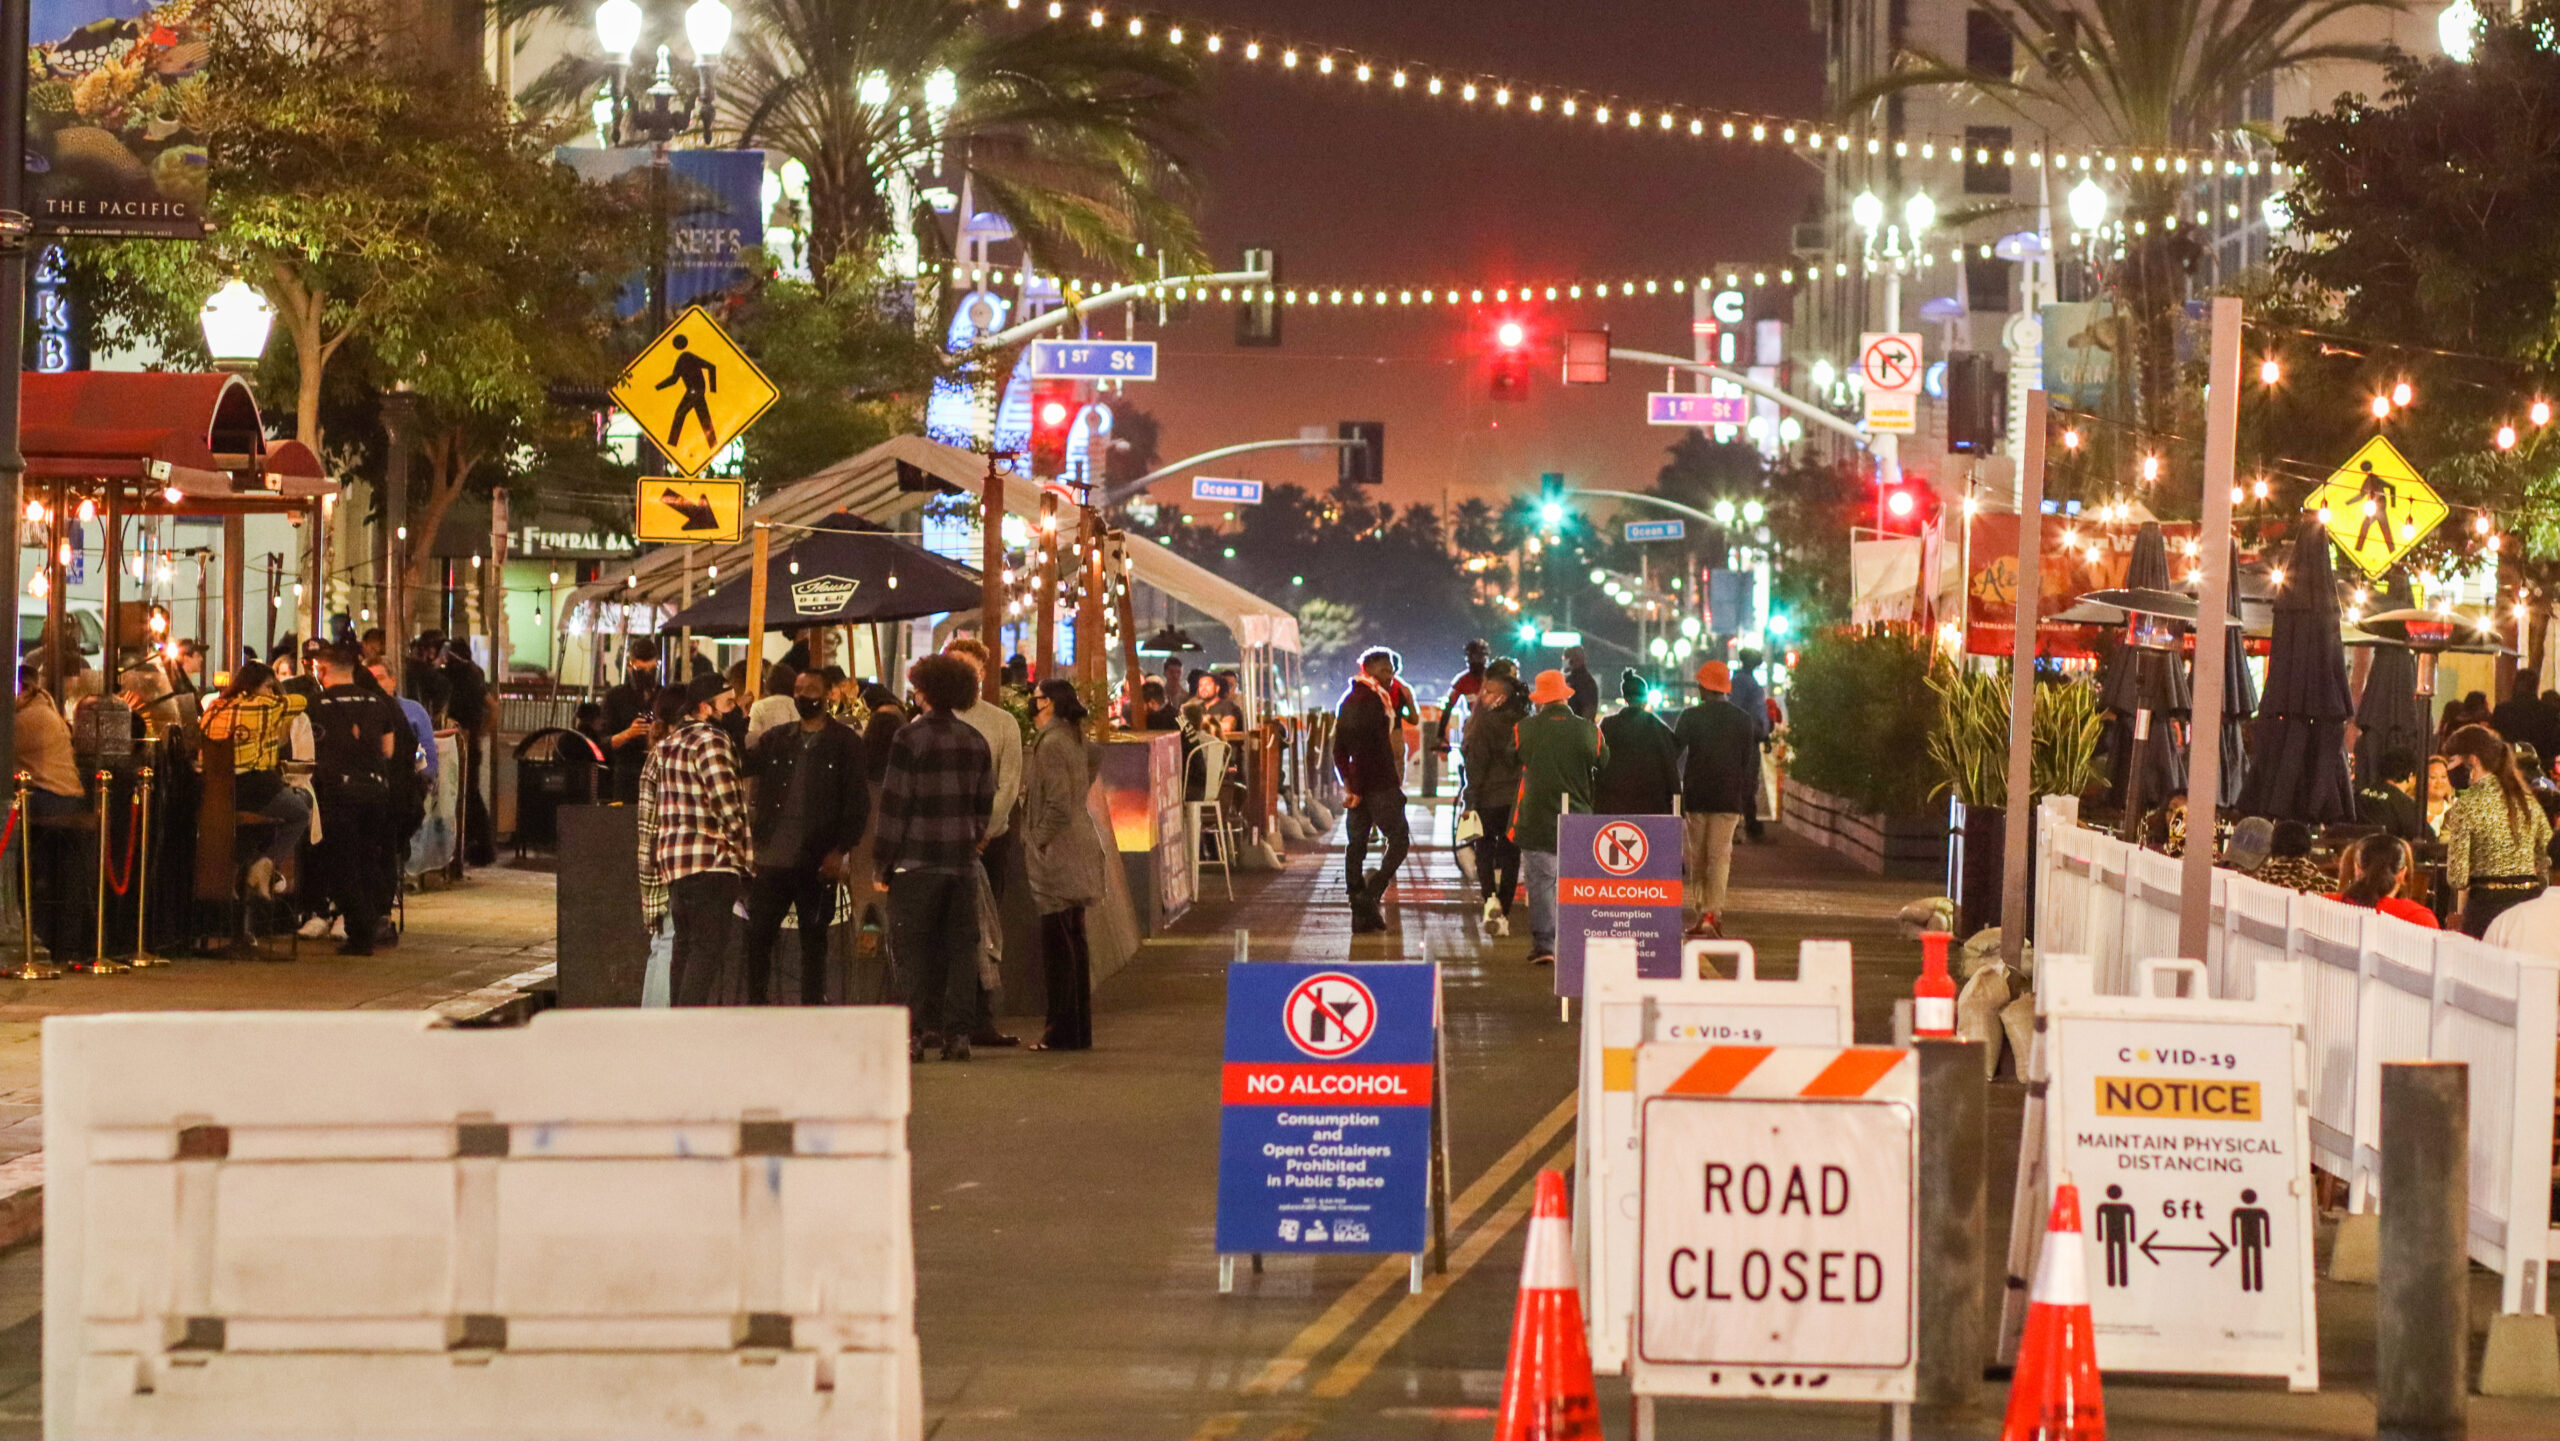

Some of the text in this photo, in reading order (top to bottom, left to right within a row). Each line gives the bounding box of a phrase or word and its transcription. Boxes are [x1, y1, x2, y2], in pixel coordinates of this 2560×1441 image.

[46, 199, 185, 217] THE PACIFIC
[1056, 348, 1135, 370] 1ST St
[1667, 400, 1732, 418] 1ST St
[1200, 482, 1237, 496] Ocean
[522, 525, 601, 554] FEDERAL
[1631, 526, 1663, 536] Ocean
[797, 580, 852, 594] House
[1573, 885, 1668, 898] NO ALCOHOL
[1591, 909, 1652, 919] Consumption
[1583, 928, 1659, 938] Open Containers
[1246, 1074, 1407, 1094] NO ALCOHOL
[2104, 1081, 2252, 1114] NOTICE
[1276, 1112, 1379, 1126] Consumption
[1312, 1128, 1342, 1141] and
[2077, 1132, 2282, 1154] MAINTAIN PHYSICAL
[1262, 1143, 1391, 1159] Open Containers
[1285, 1158, 1366, 1172] Prohibited
[2117, 1153, 2243, 1173] DISTANCING
[1266, 1173, 1385, 1190] in Public Space
[1703, 1161, 1850, 1217] ROAD
[2161, 1198, 2204, 1220] 6ft
[1668, 1246, 1883, 1303] CLOSED
